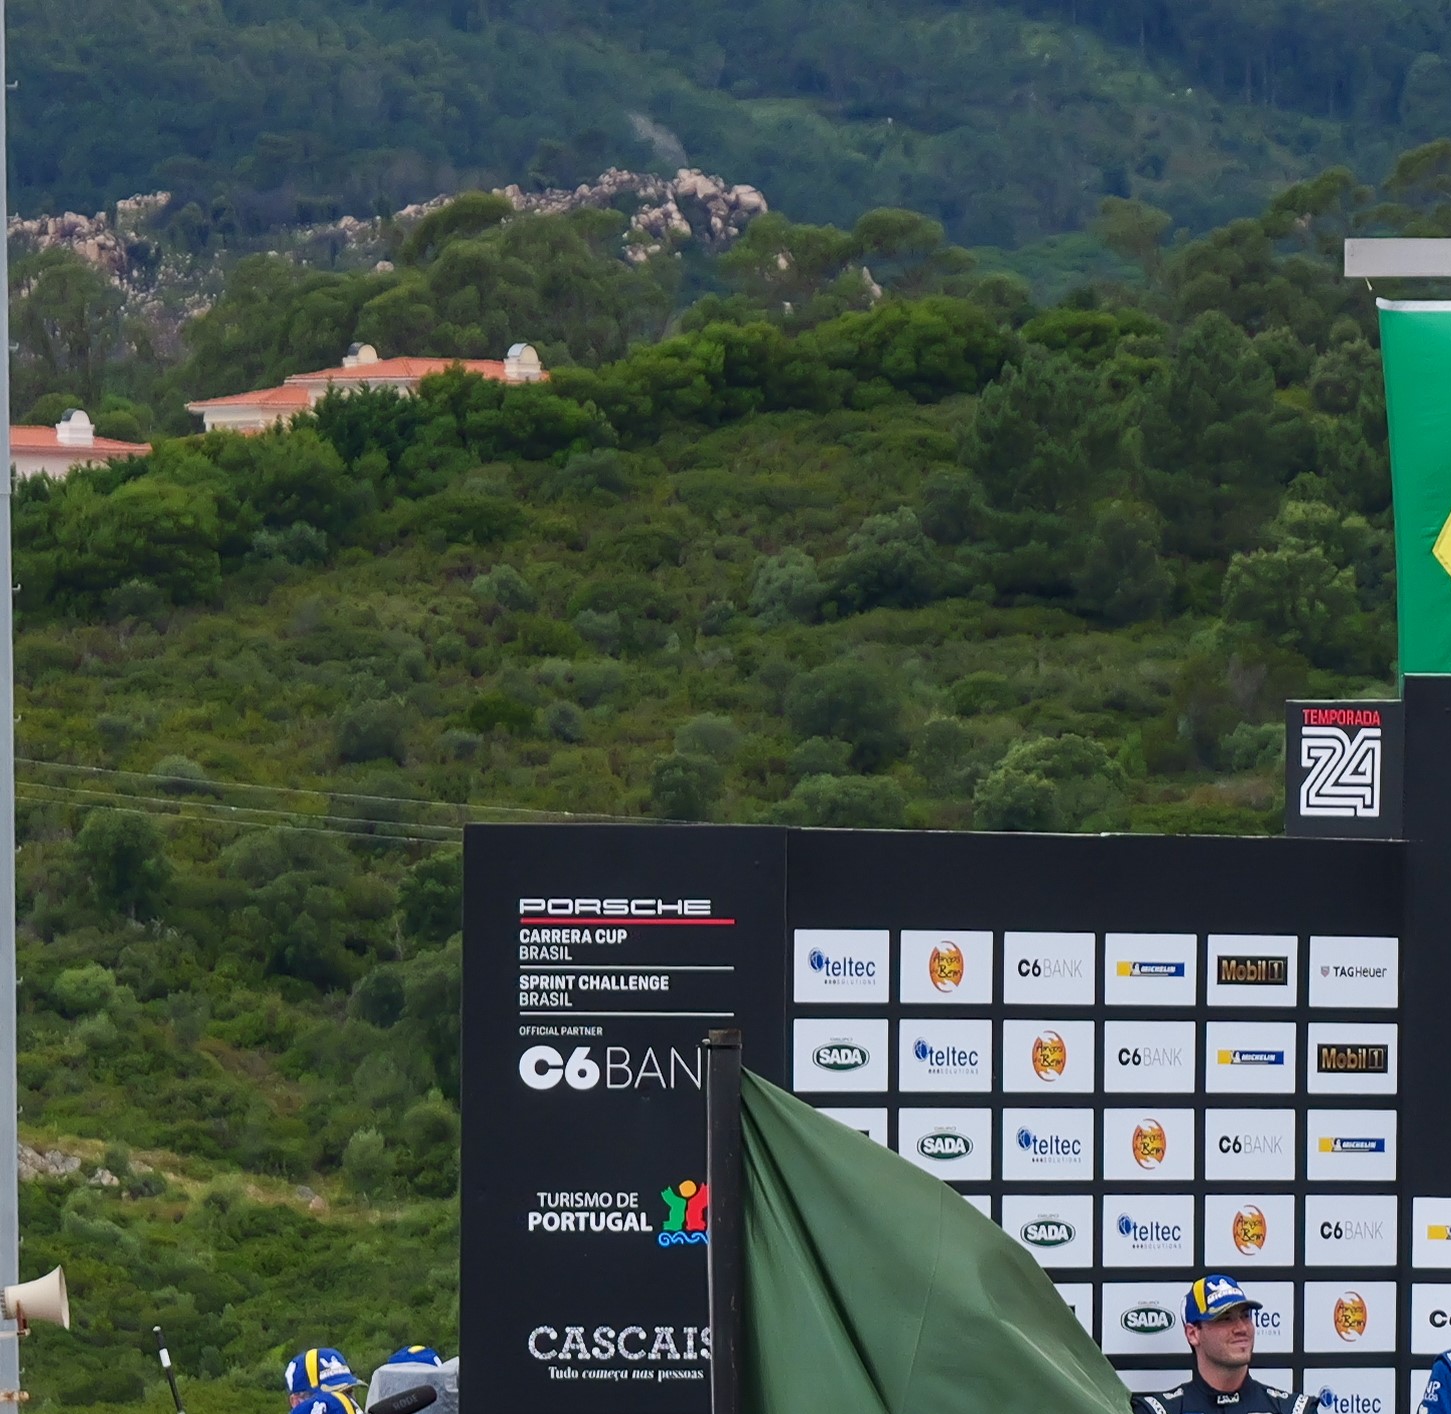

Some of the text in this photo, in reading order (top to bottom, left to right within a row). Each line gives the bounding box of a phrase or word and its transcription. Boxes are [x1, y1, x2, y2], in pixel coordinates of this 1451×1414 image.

[1302, 709, 1380, 725] TEMPORADA
[1300, 726, 1381, 817] 24
[520, 899, 711, 915] PORSCHE
[520, 929, 627, 944] CARRERA CUP
[520, 946, 572, 960] BRASIL
[823, 956, 875, 978] teltec
[520, 975, 669, 990] SPRINT CHALLENGE
[520, 992, 572, 1006] BRASIL
[519, 1026, 602, 1036] OFFICIAL PARTNER
[816, 1048, 862, 1067] SADA
[927, 1045, 978, 1067] teltec
[921, 1138, 966, 1156] SADA
[1032, 1133, 1080, 1155] teltec
[537, 1192, 638, 1208] TURISMO DE
[529, 1212, 653, 1231] PORTUGAL
[1026, 1225, 1069, 1241] SADA
[1132, 1219, 1180, 1241] teltec
[1125, 1312, 1171, 1328] SADA
[549, 1367, 703, 1382] Tudo começa nas pessoas
[1333, 1392, 1381, 1413] teltec
